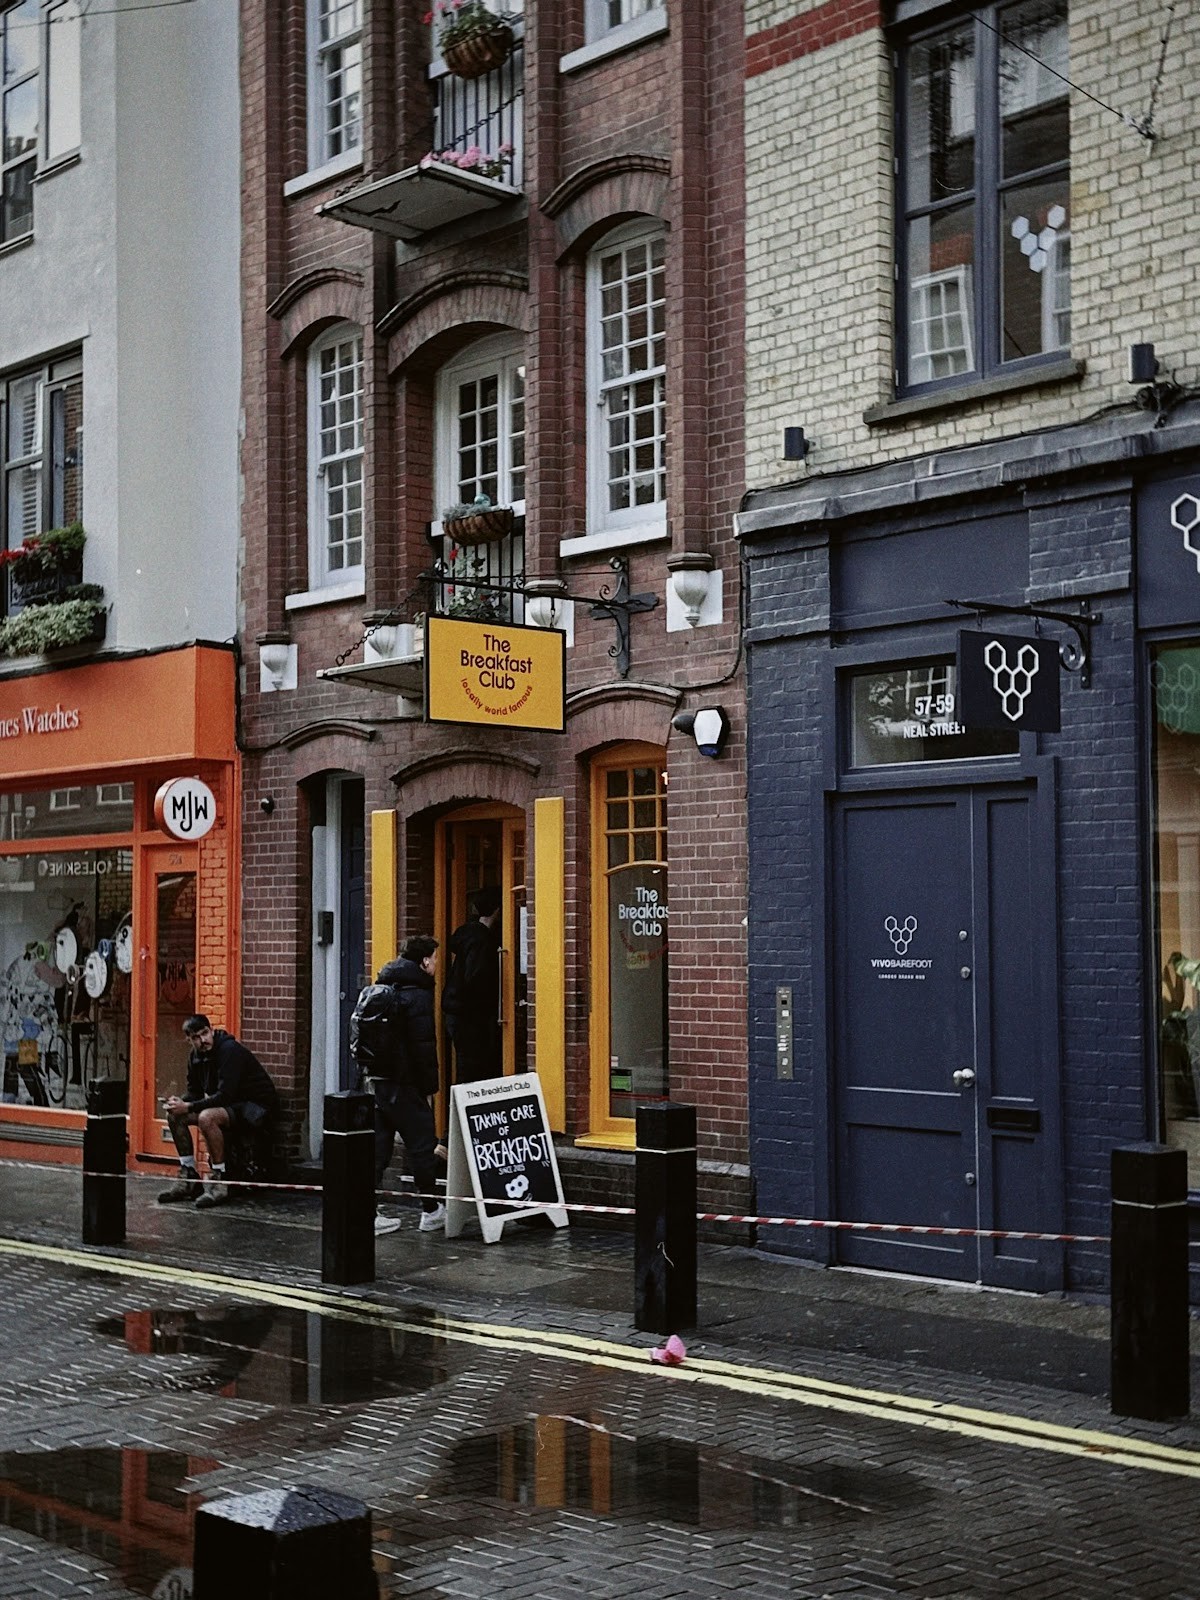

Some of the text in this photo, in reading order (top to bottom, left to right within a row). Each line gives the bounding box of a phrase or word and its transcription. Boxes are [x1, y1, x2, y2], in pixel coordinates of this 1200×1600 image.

[483, 634, 511, 653] The
[461, 650, 532, 673] Breakfast
[479, 671, 515, 690] Club
[461, 678, 533, 716] locally world famous
[915, 693, 954, 715] 57-59
[22, 703, 79, 734] Watches
[903, 724, 928, 739] NEAL
[172, 791, 208, 832] MJW
[635, 887, 658, 902] The
[618, 903, 669, 919] Breakfas
[632, 920, 662, 936] Club
[870, 959, 933, 968] VIVOBAREFOOT
[467, 1081, 531, 1098] The Breakfast Club
[470, 1104, 537, 1133] TAKING CARE
[498, 1126, 510, 1136] OF
[475, 1133, 549, 1171] BREAKFAST
